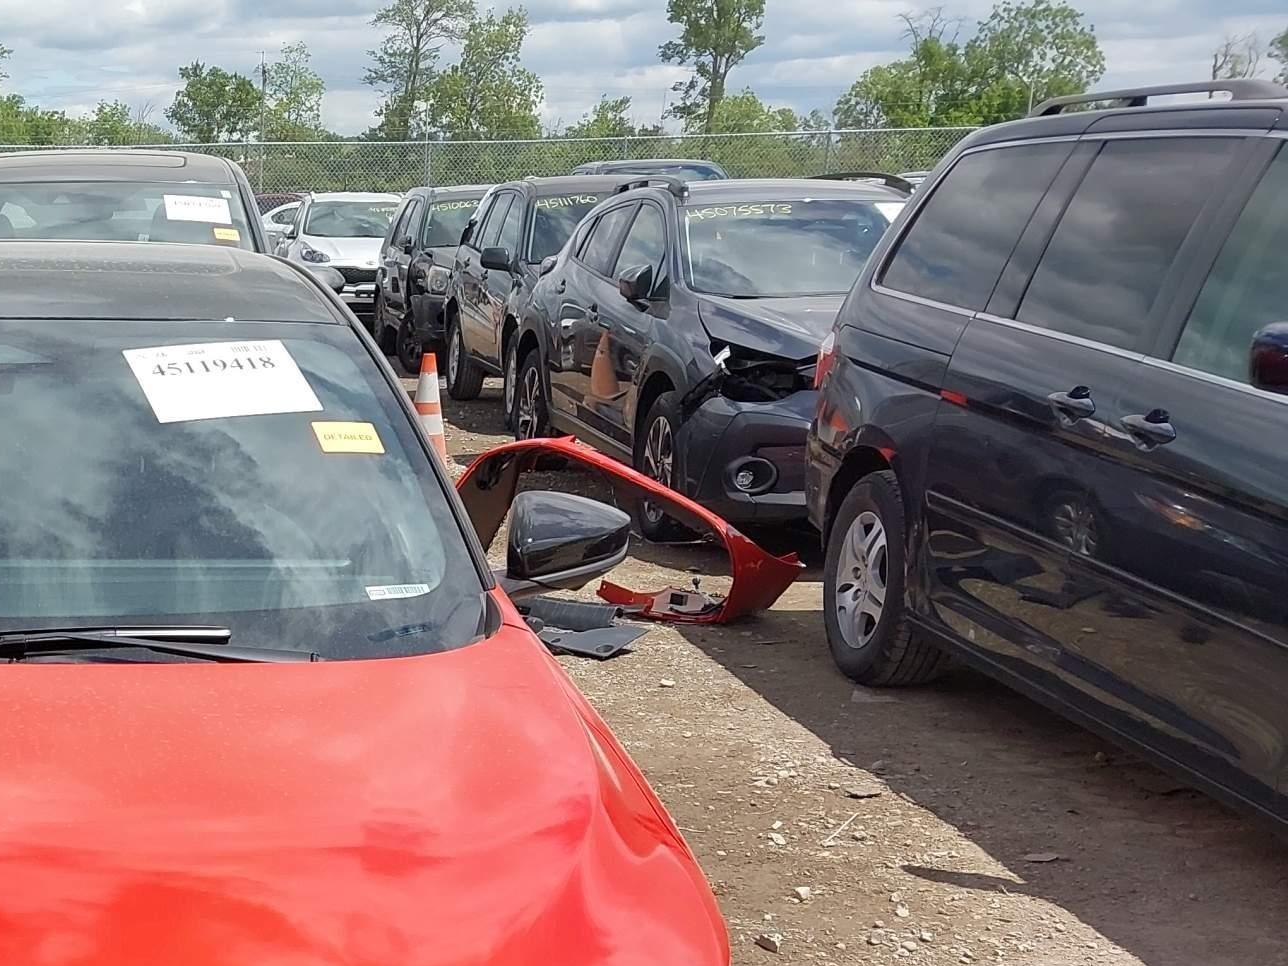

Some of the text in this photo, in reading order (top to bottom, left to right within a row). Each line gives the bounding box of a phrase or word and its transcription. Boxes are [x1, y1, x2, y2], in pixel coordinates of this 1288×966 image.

[535, 195, 598, 209] 45111760
[686, 203, 793, 219] 45075573
[151, 356, 276, 376] 45119418
